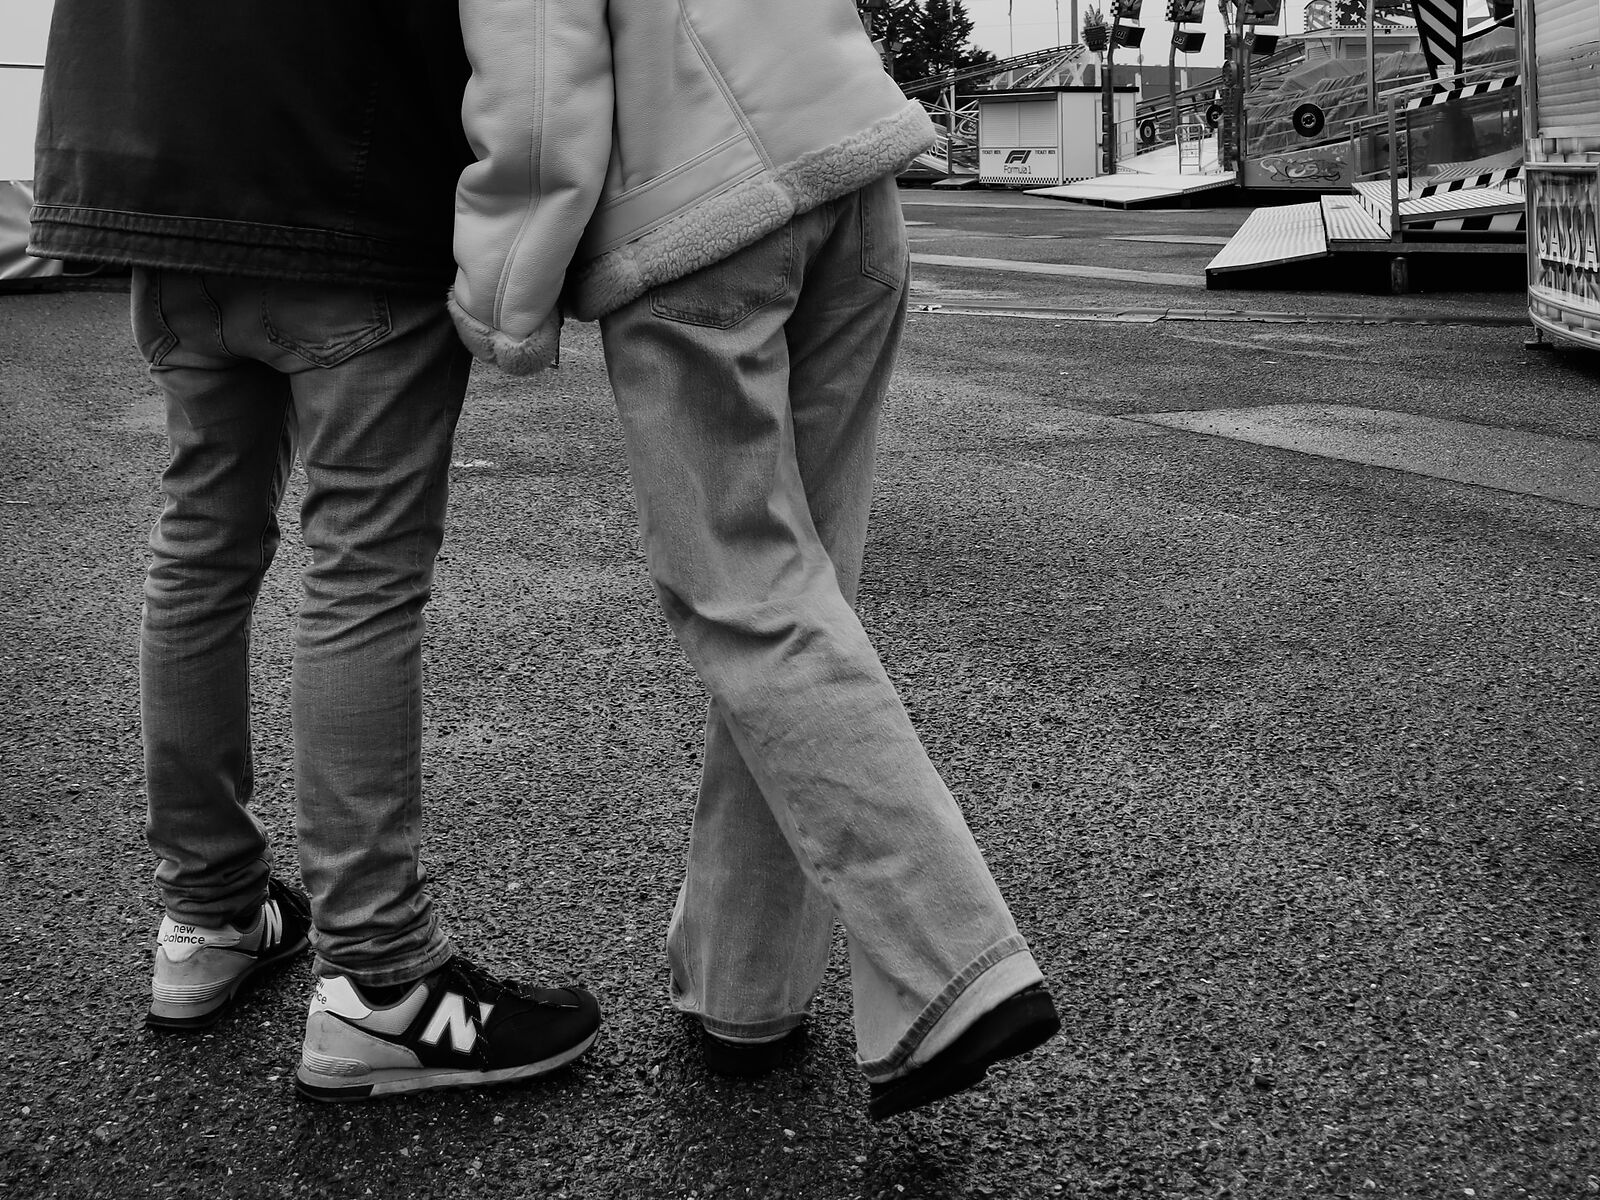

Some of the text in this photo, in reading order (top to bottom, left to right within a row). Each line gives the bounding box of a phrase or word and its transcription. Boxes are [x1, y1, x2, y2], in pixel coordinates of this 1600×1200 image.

[174, 925, 196, 934] new
[164, 934, 205, 944] balance
[419, 992, 495, 1054] N
